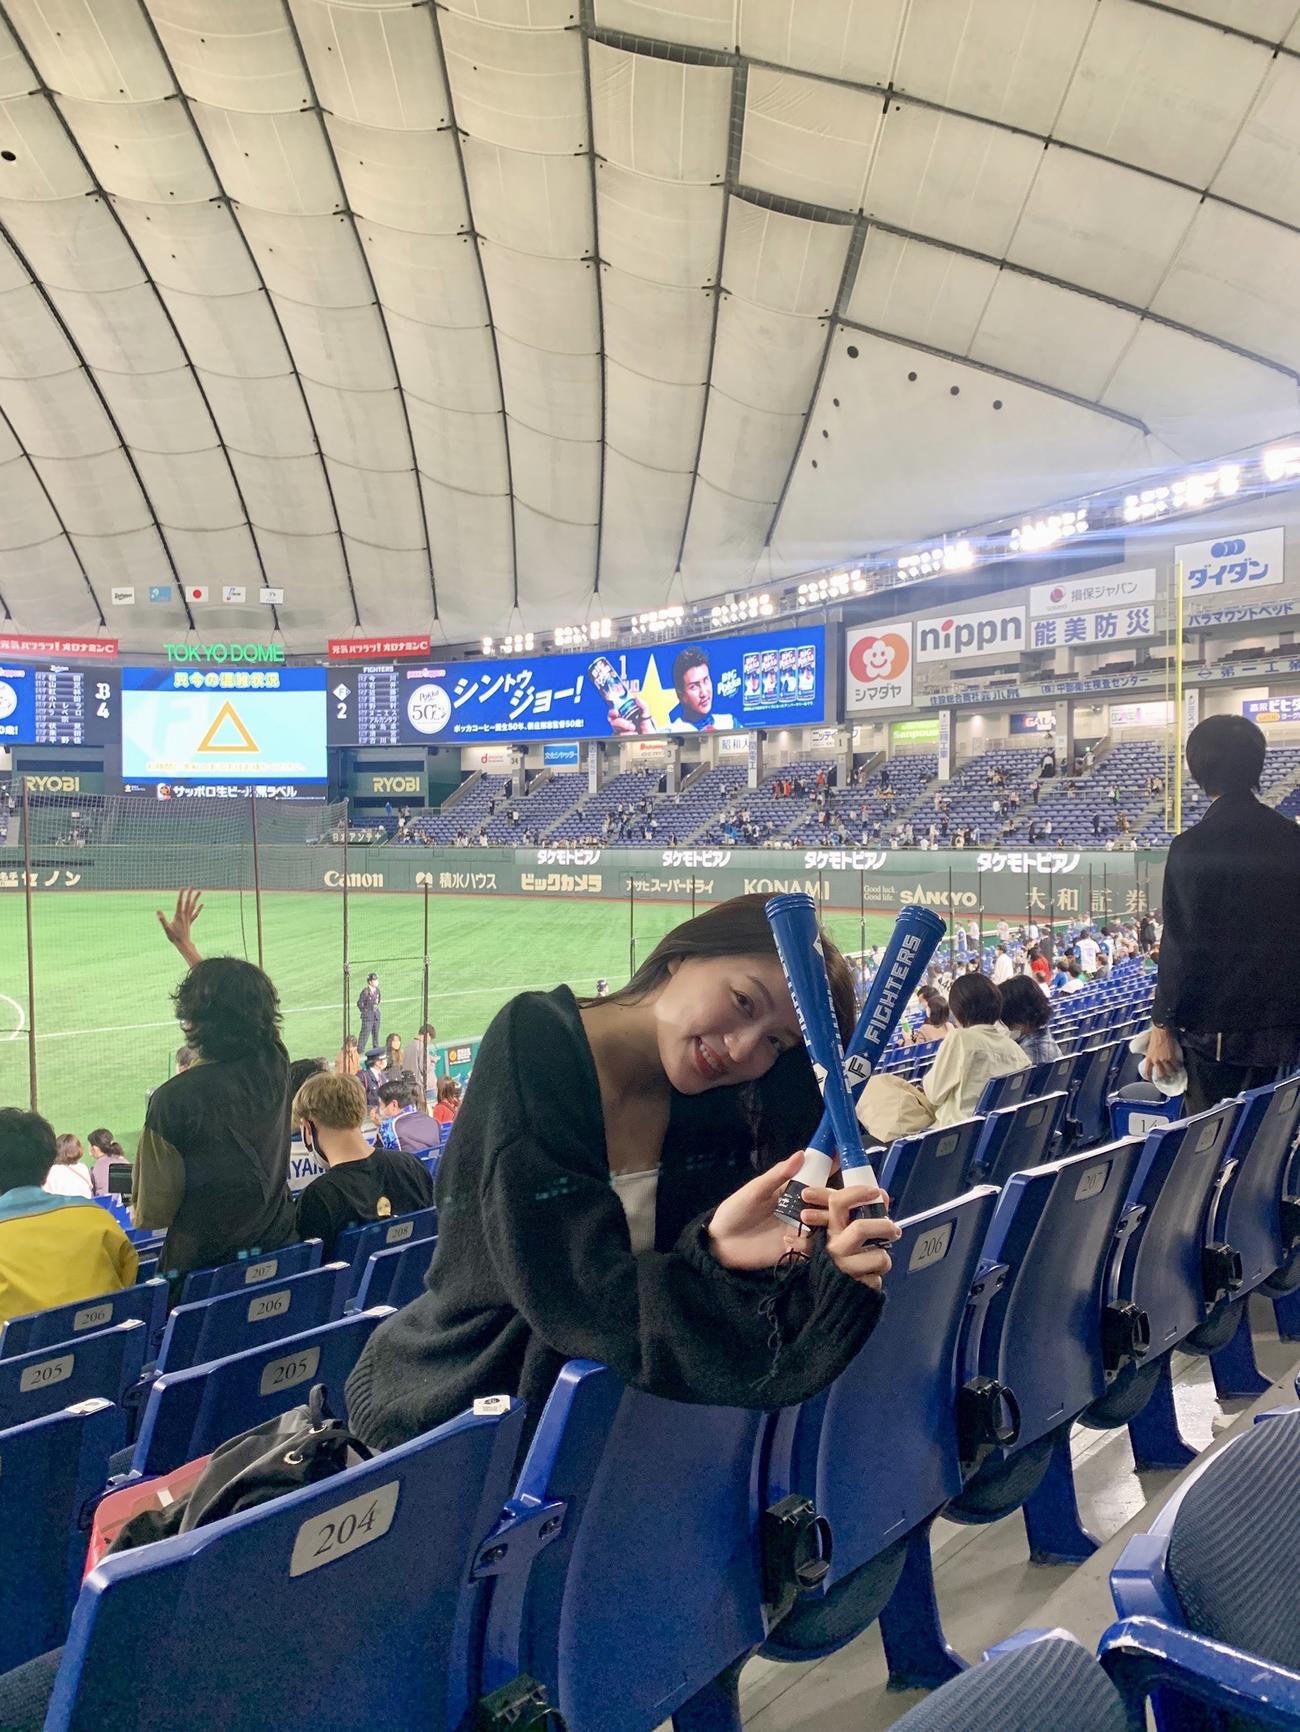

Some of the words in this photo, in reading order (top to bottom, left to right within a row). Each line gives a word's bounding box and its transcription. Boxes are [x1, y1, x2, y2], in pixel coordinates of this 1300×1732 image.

[1188, 557, 1269, 589] ダイダン
[1072, 582, 1138, 602] 損保ジャパン
[1189, 602, 1294, 626] パラマウントベッド
[920, 616, 1022, 654] nippn
[1034, 608, 1150, 646] 能美防災
[163, 644, 227, 663] TOKYO
[231, 644, 286, 663] DOME
[453, 669, 533, 709] シントウ
[508, 675, 584, 720] ジョー!
[855, 684, 901, 702] シマダヤ
[96, 702, 110, 719] 4
[337, 703, 347, 719] 2
[26, 776, 80, 792] RYOBI
[373, 777, 420, 793] RYOBI
[537, 850, 600, 865] タケモトピアノ
[662, 850, 731, 868] タケモトピアノ
[804, 851, 887, 870] タケモトピアノ
[976, 852, 1081, 874] タケモトピアノ
[324, 870, 384, 888] Canon
[439, 872, 497, 890] 積水ハウス
[521, 873, 603, 893] ビックカメラ
[744, 878, 829, 900] KONAMI
[864, 884, 881, 892] Good
[864, 892, 881, 900] Good
[900, 883, 977, 907] SANKYO
[1026, 886, 1148, 913] 大和証券
[864, 934, 921, 1045] FIGHTERS
[917, 1233, 944, 1262] 206
[256, 1297, 283, 1316] 206
[32, 1362, 63, 1384] 205
[273, 1359, 308, 1384] 205
[312, 1499, 378, 1557] 204
